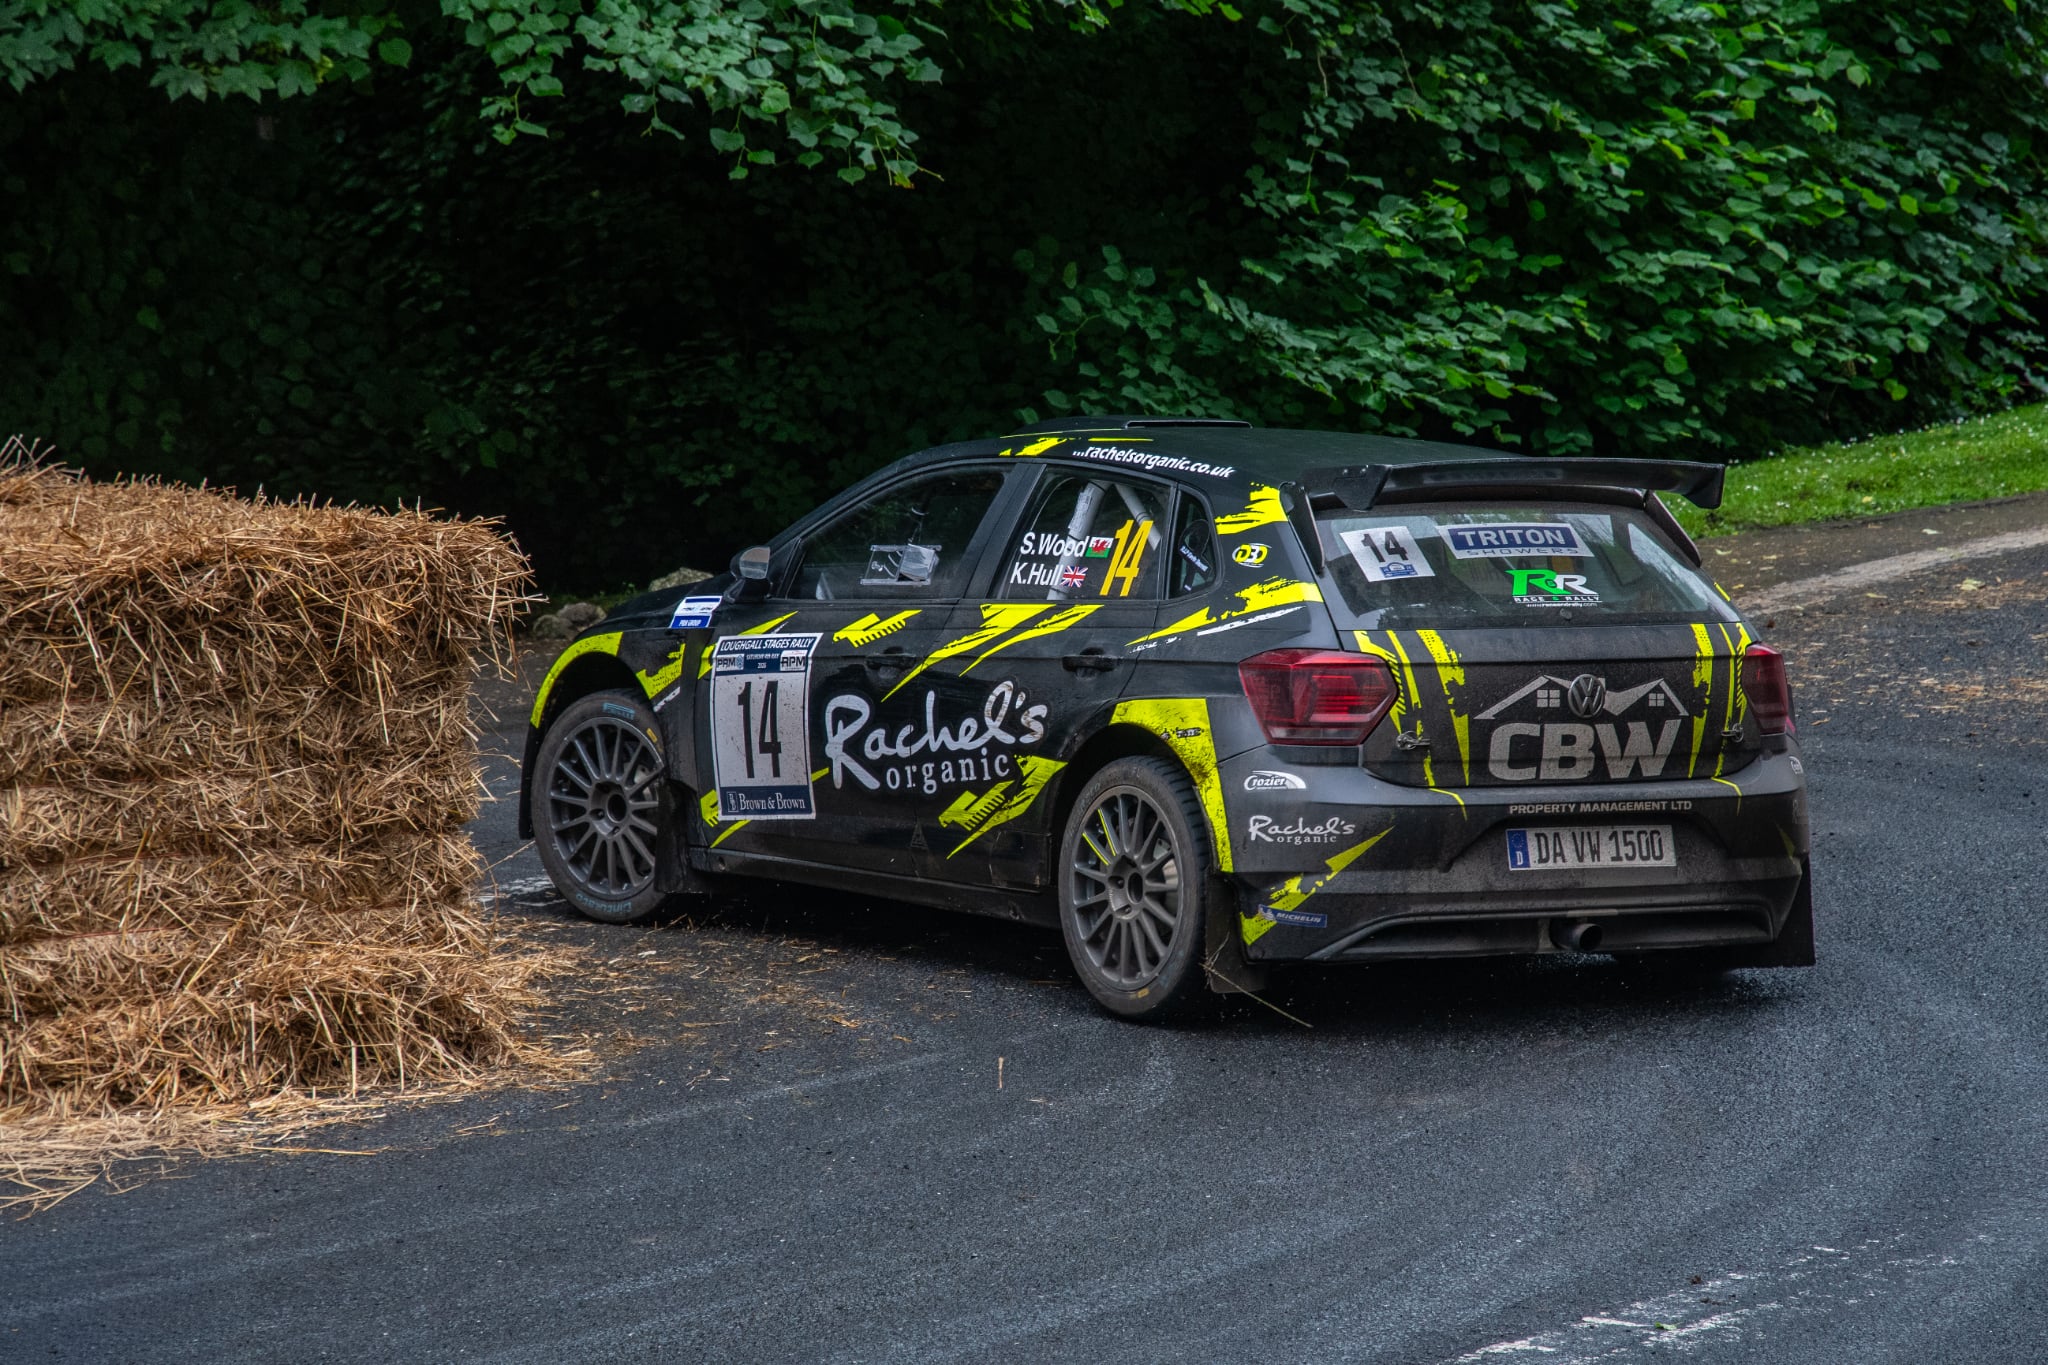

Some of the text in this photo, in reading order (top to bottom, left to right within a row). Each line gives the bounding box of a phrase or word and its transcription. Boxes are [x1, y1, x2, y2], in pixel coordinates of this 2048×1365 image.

[1019, 531, 1090, 558] S.Wood
[1361, 531, 1409, 563] 14
[1457, 528, 1567, 547] TRITON
[1099, 519, 1154, 597] 14
[1467, 547, 1579, 556] SHOWERS
[1010, 562, 1064, 587] K.Hull
[720, 637, 814, 652] LOUGHGALL STAGES RALLY
[737, 680, 782, 779] 14
[825, 680, 1048, 790] Rachel's
[1488, 719, 1682, 781] CBW
[886, 747, 1011, 794] organic
[1244, 775, 1287, 790] Crozier
[738, 793, 767, 810] Brown
[767, 797, 775, 809] &
[775, 792, 806, 810] Brown
[1509, 801, 1693, 815] PROPERTY MANAGEMENT LTD
[1248, 815, 1356, 842] Rachel's
[1277, 834, 1337, 845] organic
[1516, 829, 1665, 866] D DA VW 1500
[1276, 912, 1322, 923] MICHELIN
